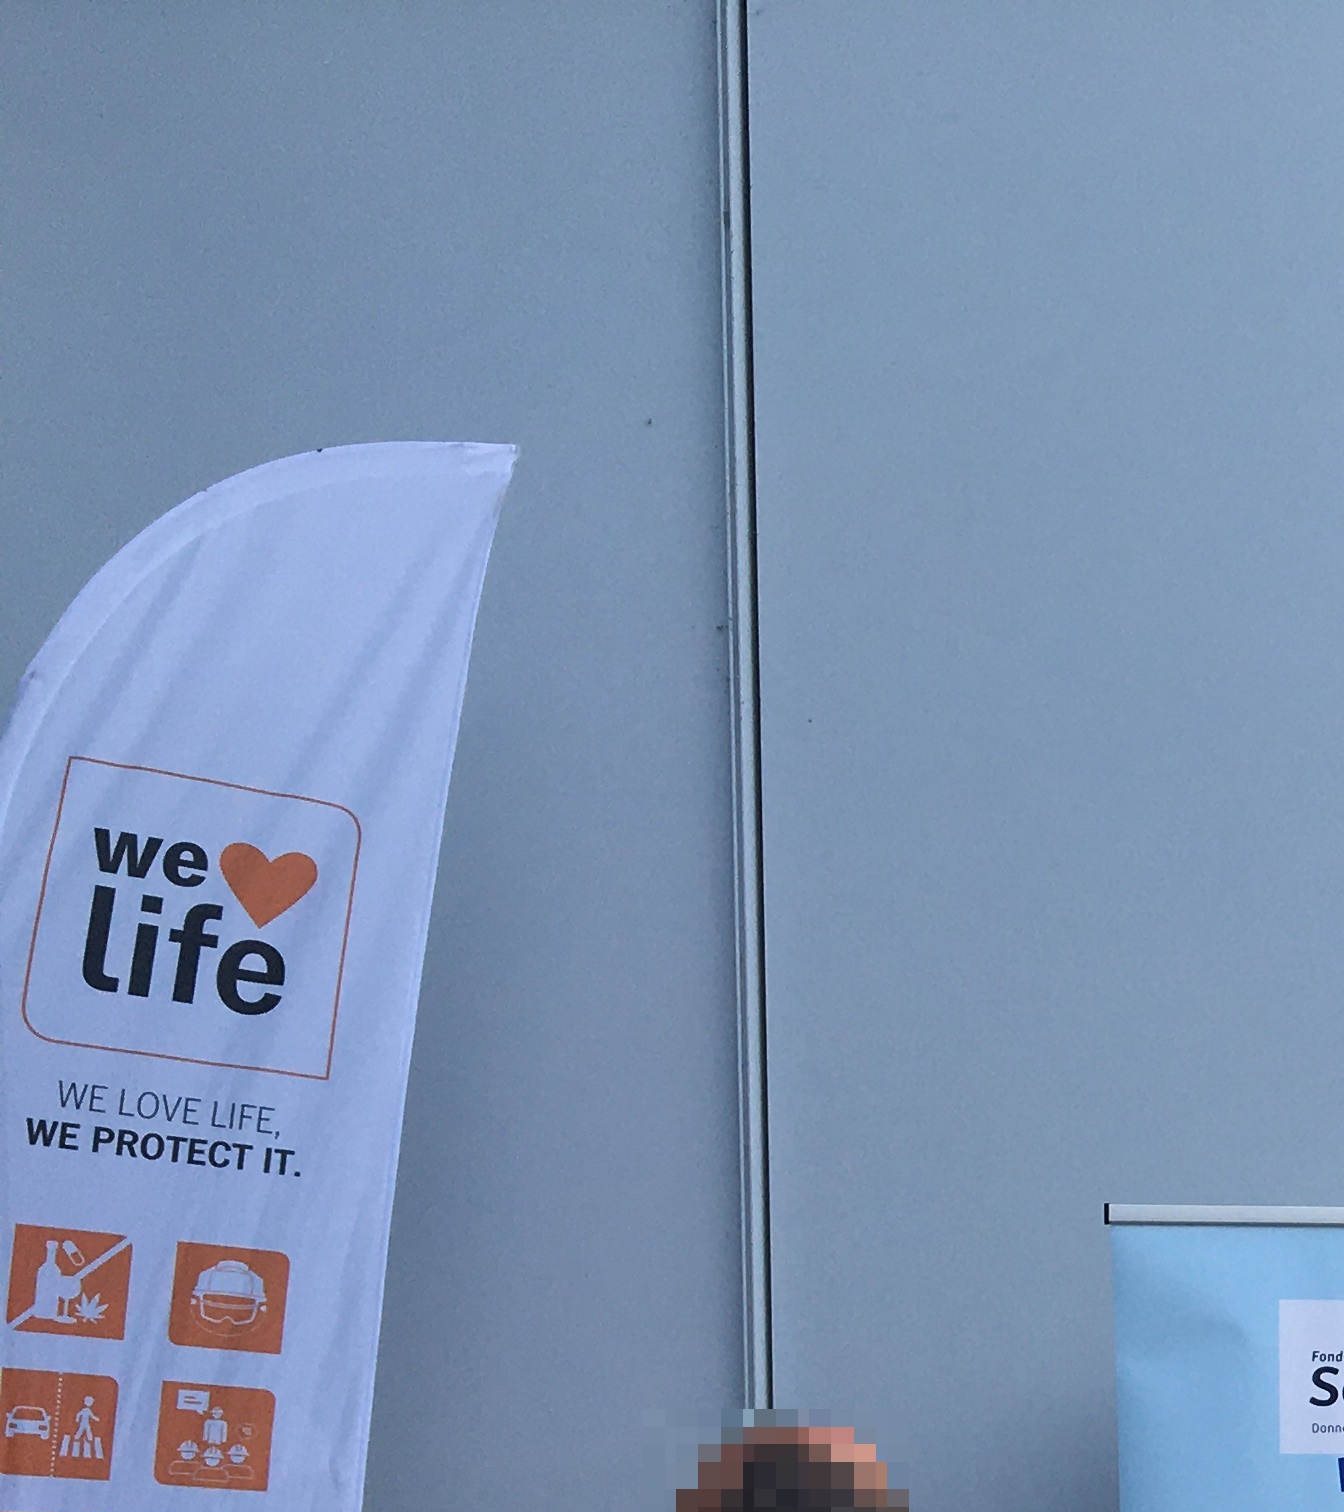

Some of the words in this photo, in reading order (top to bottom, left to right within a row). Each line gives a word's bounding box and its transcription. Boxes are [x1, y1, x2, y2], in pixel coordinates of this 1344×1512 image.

[93, 826, 209, 888] we
[81, 884, 286, 1016] life
[58, 1079, 108, 1115] WE
[118, 1087, 202, 1126] LOVE
[210, 1099, 281, 1139] LIFE,
[26, 1117, 81, 1151] WE
[92, 1125, 253, 1171] PROTECT
[263, 1145, 302, 1177] IT.
